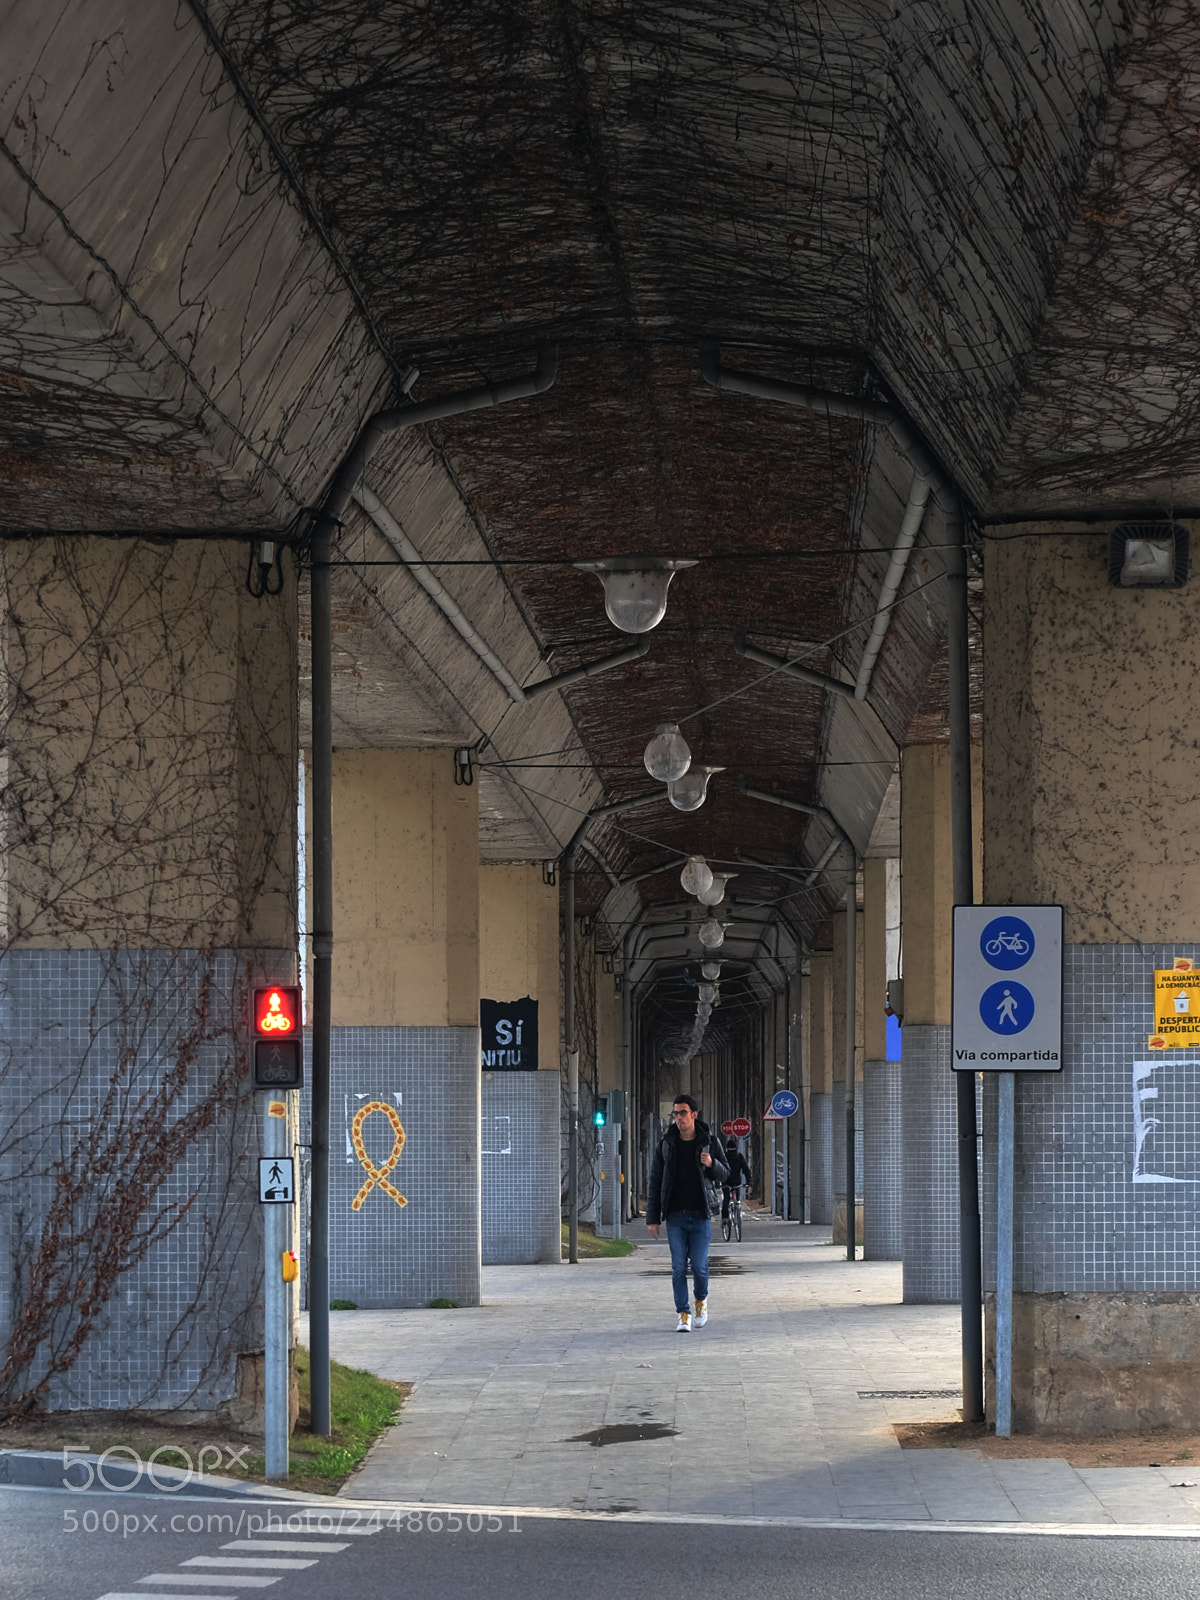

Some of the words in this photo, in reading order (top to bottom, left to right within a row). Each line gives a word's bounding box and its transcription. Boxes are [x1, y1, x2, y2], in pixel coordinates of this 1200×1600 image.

[495, 1019, 524, 1045] Sí
[955, 1050, 976, 1061] Via
[980, 1050, 1058, 1062] compartida
